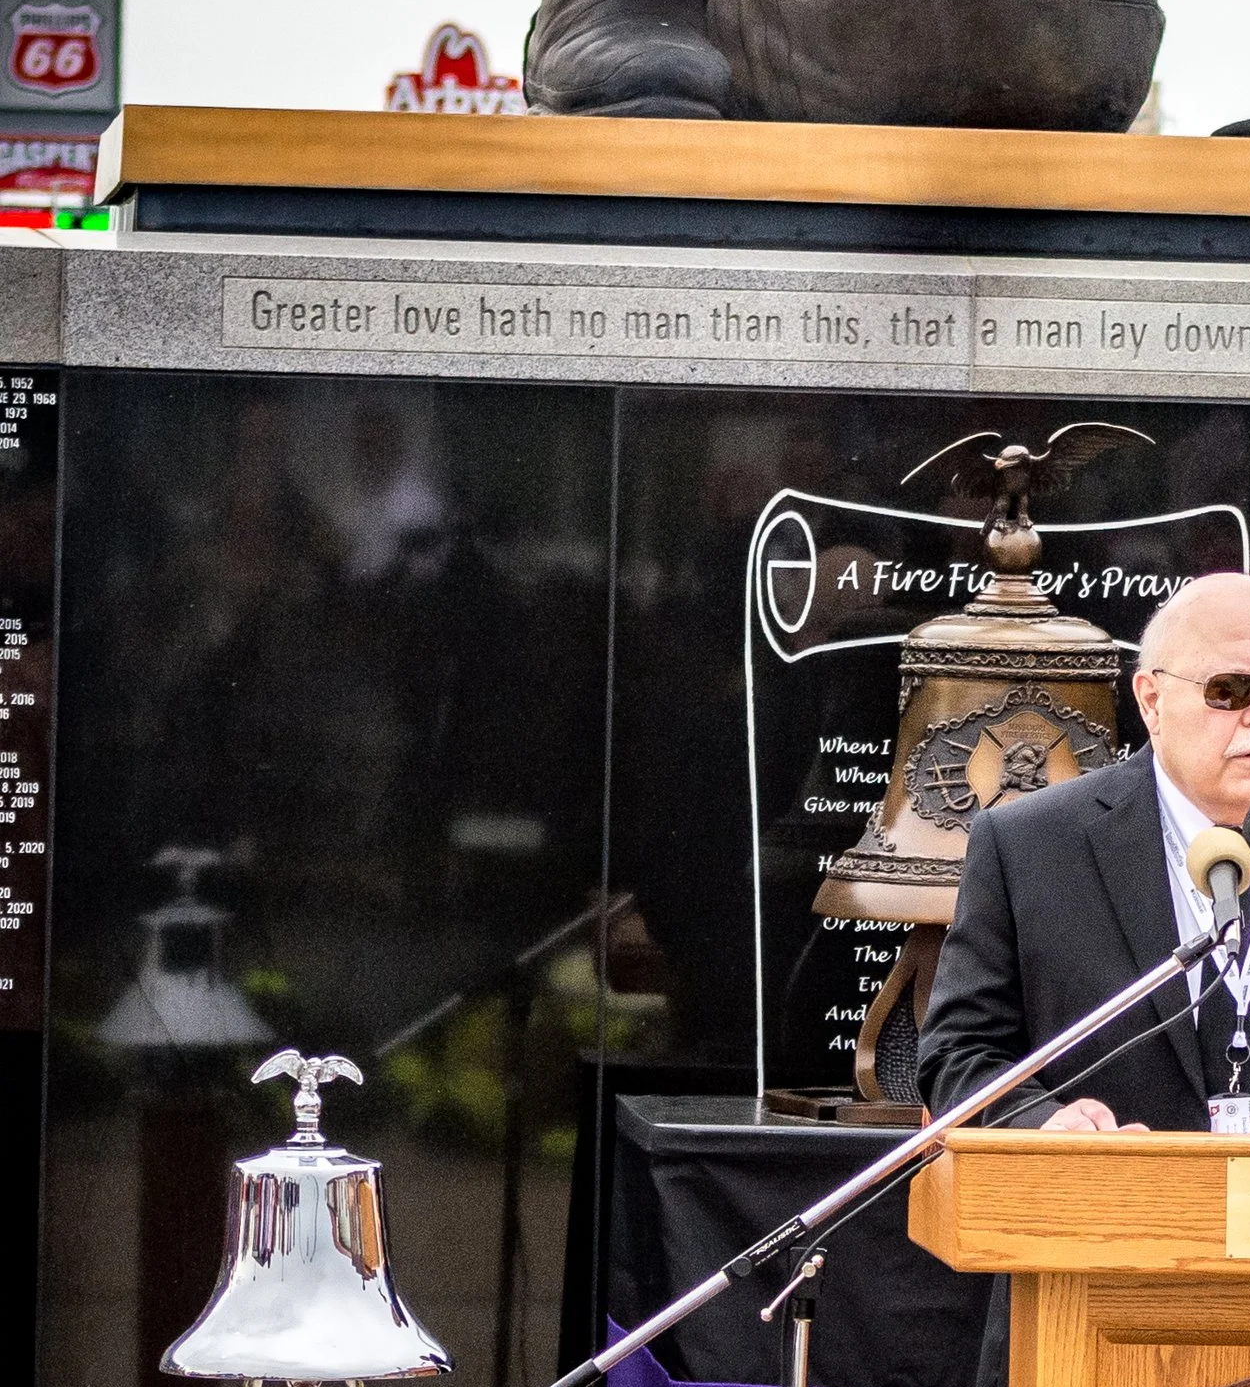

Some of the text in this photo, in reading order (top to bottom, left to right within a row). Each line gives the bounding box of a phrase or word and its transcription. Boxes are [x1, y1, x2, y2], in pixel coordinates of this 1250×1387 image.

[22, 39, 86, 78] 66
[251, 290, 376, 333] Greater
[394, 294, 460, 336] love
[479, 298, 552, 338] hath
[569, 310, 607, 340] no
[625, 311, 691, 341] man
[710, 304, 781, 343] than
[801, 306, 870, 348] this,
[889, 307, 957, 348] that
[981, 317, 998, 348] a
[1016, 318, 1082, 351] man
[1100, 312, 1147, 358] lay
[11, 377, 34, 390] 1952
[33, 393, 57, 405] 1968
[5, 407, 28, 420] 1973
[837, 561, 1196, 608] A Fire Fier's Pray
[0, 618, 22, 630] 2015
[4, 633, 28, 645] 2015
[11, 693, 35, 706] 2016
[819, 736, 891, 755] When I
[835, 766, 890, 784] When
[15, 782, 39, 794] 2019
[10, 797, 35, 808] 2019
[804, 797, 850, 814] Give
[19, 842, 45, 854] 2020
[7, 902, 33, 915] 2020
[854, 945, 893, 963] The
[825, 1005, 867, 1021] And
[828, 1035, 856, 1050] An
